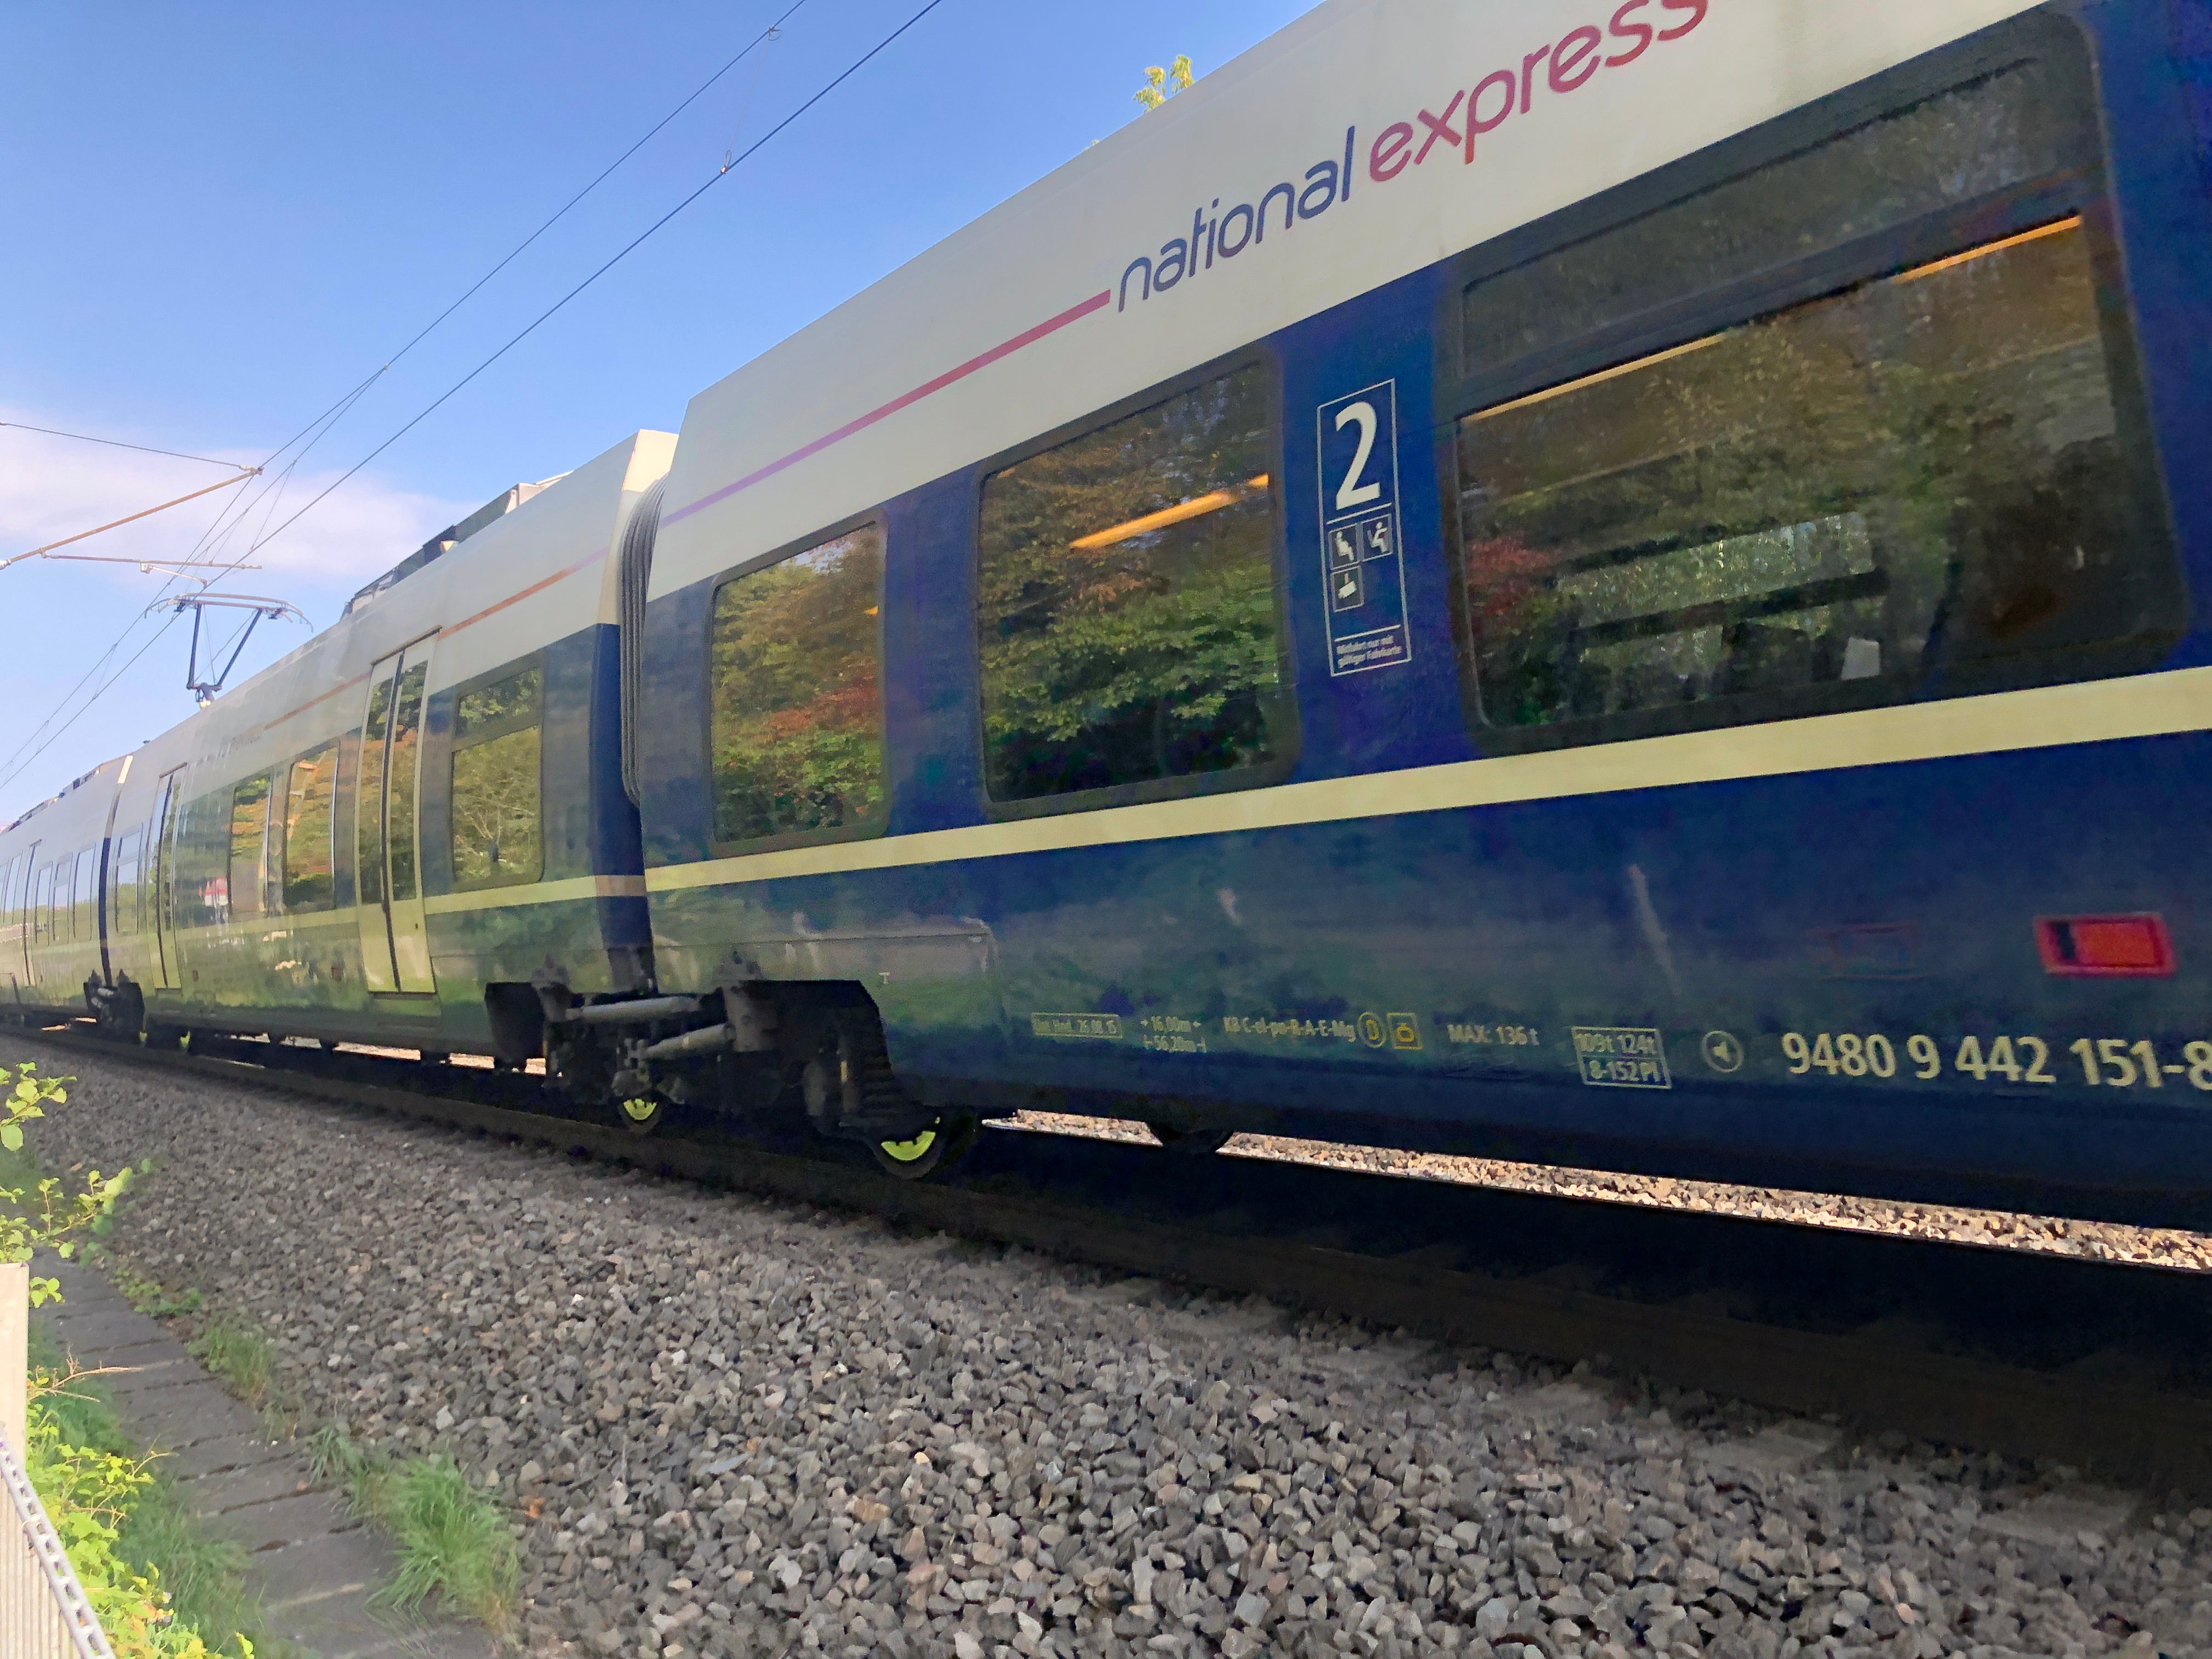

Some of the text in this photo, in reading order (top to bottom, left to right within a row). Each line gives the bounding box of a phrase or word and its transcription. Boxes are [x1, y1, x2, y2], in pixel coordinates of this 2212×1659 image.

[1118, 0, 1708, 313] national express
[1335, 401, 1381, 510] 2
[1782, 1032, 2212, 1091] 9480 9 442 151-8
